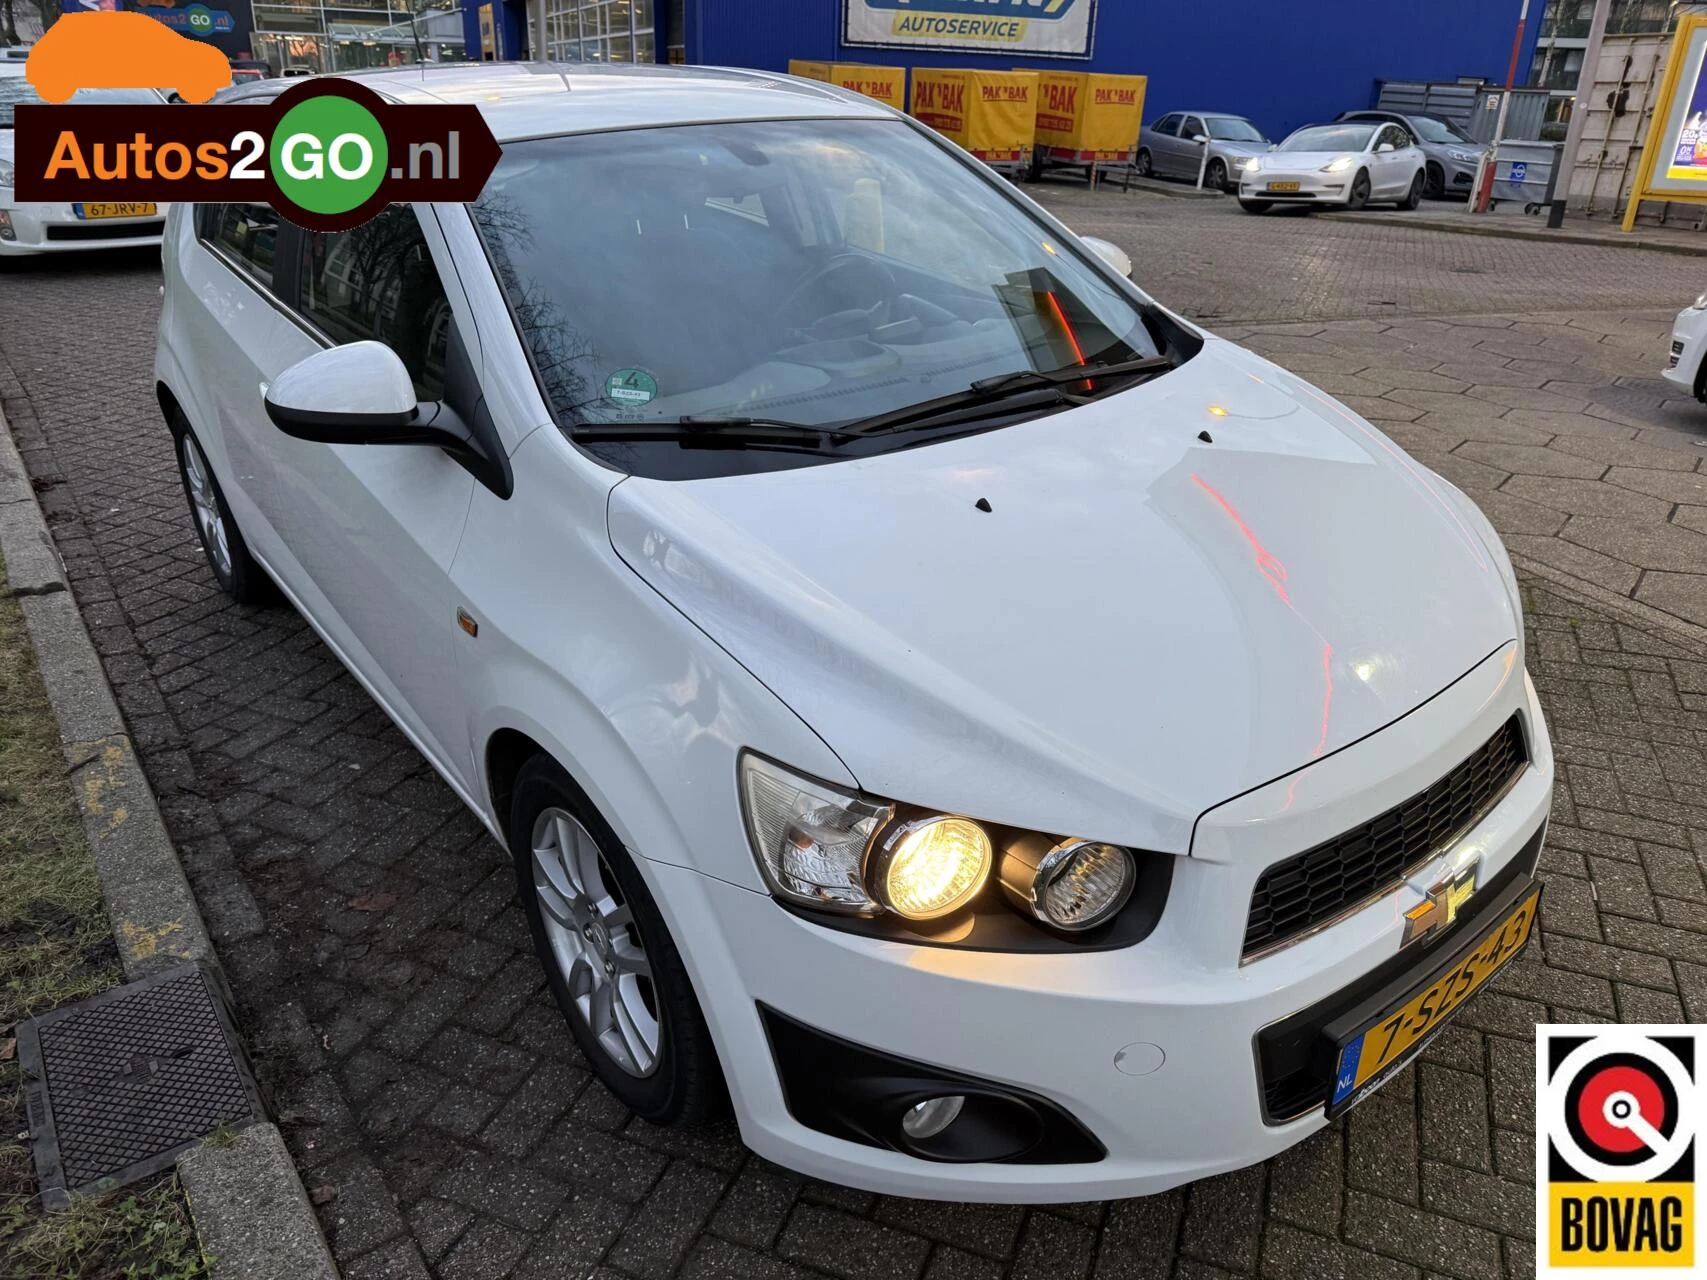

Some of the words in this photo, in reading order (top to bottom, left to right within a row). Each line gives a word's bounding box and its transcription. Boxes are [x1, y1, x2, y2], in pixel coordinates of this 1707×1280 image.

[898, 16, 1020, 37] AUTOSERVICE
[871, 80, 893, 97] BAK
[914, 80, 936, 108] PAK
[942, 82, 965, 114] BAK
[982, 85, 1001, 99] PAK
[1008, 86, 1029, 100] BAK
[1095, 88, 1113, 102] PAK
[1118, 89, 1136, 102] BAK
[1049, 84, 1079, 114] BAK
[90, 203, 149, 216] 67-JRV-7
[624, 371, 640, 389] 4
[1375, 909, 1528, 1065] 7-SZS-43
[1336, 1074, 1353, 1094] NL
